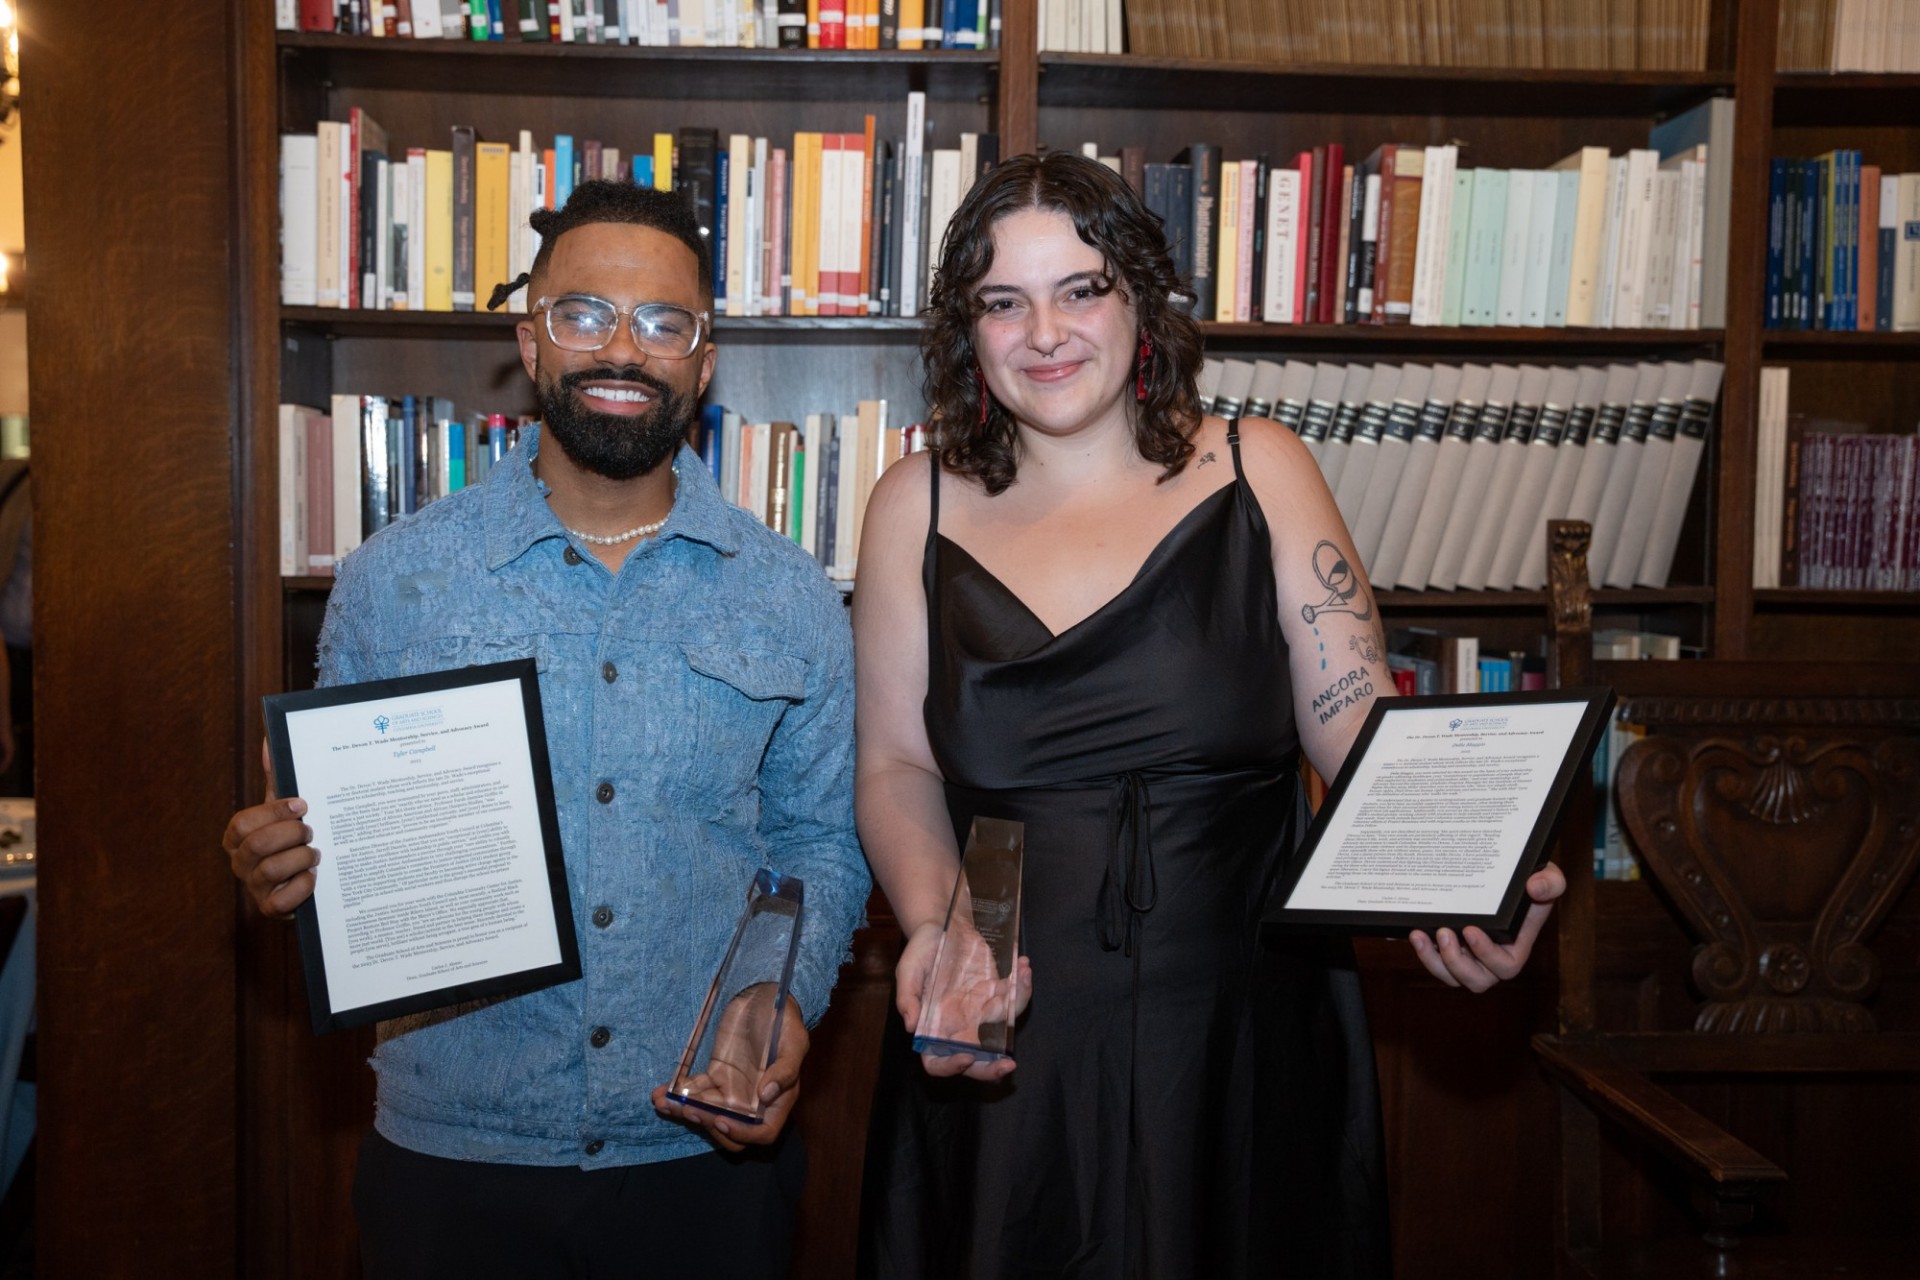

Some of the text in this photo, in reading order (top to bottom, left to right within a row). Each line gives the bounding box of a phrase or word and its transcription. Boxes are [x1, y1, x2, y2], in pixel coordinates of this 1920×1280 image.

[1276, 176, 1291, 240] GENET
[1312, 666, 1370, 712] ANCORA
[1319, 682, 1374, 725] IMPARO
[391, 708, 442, 721] GRADUATE SCHOOL
[409, 745, 436, 754] Campbell
